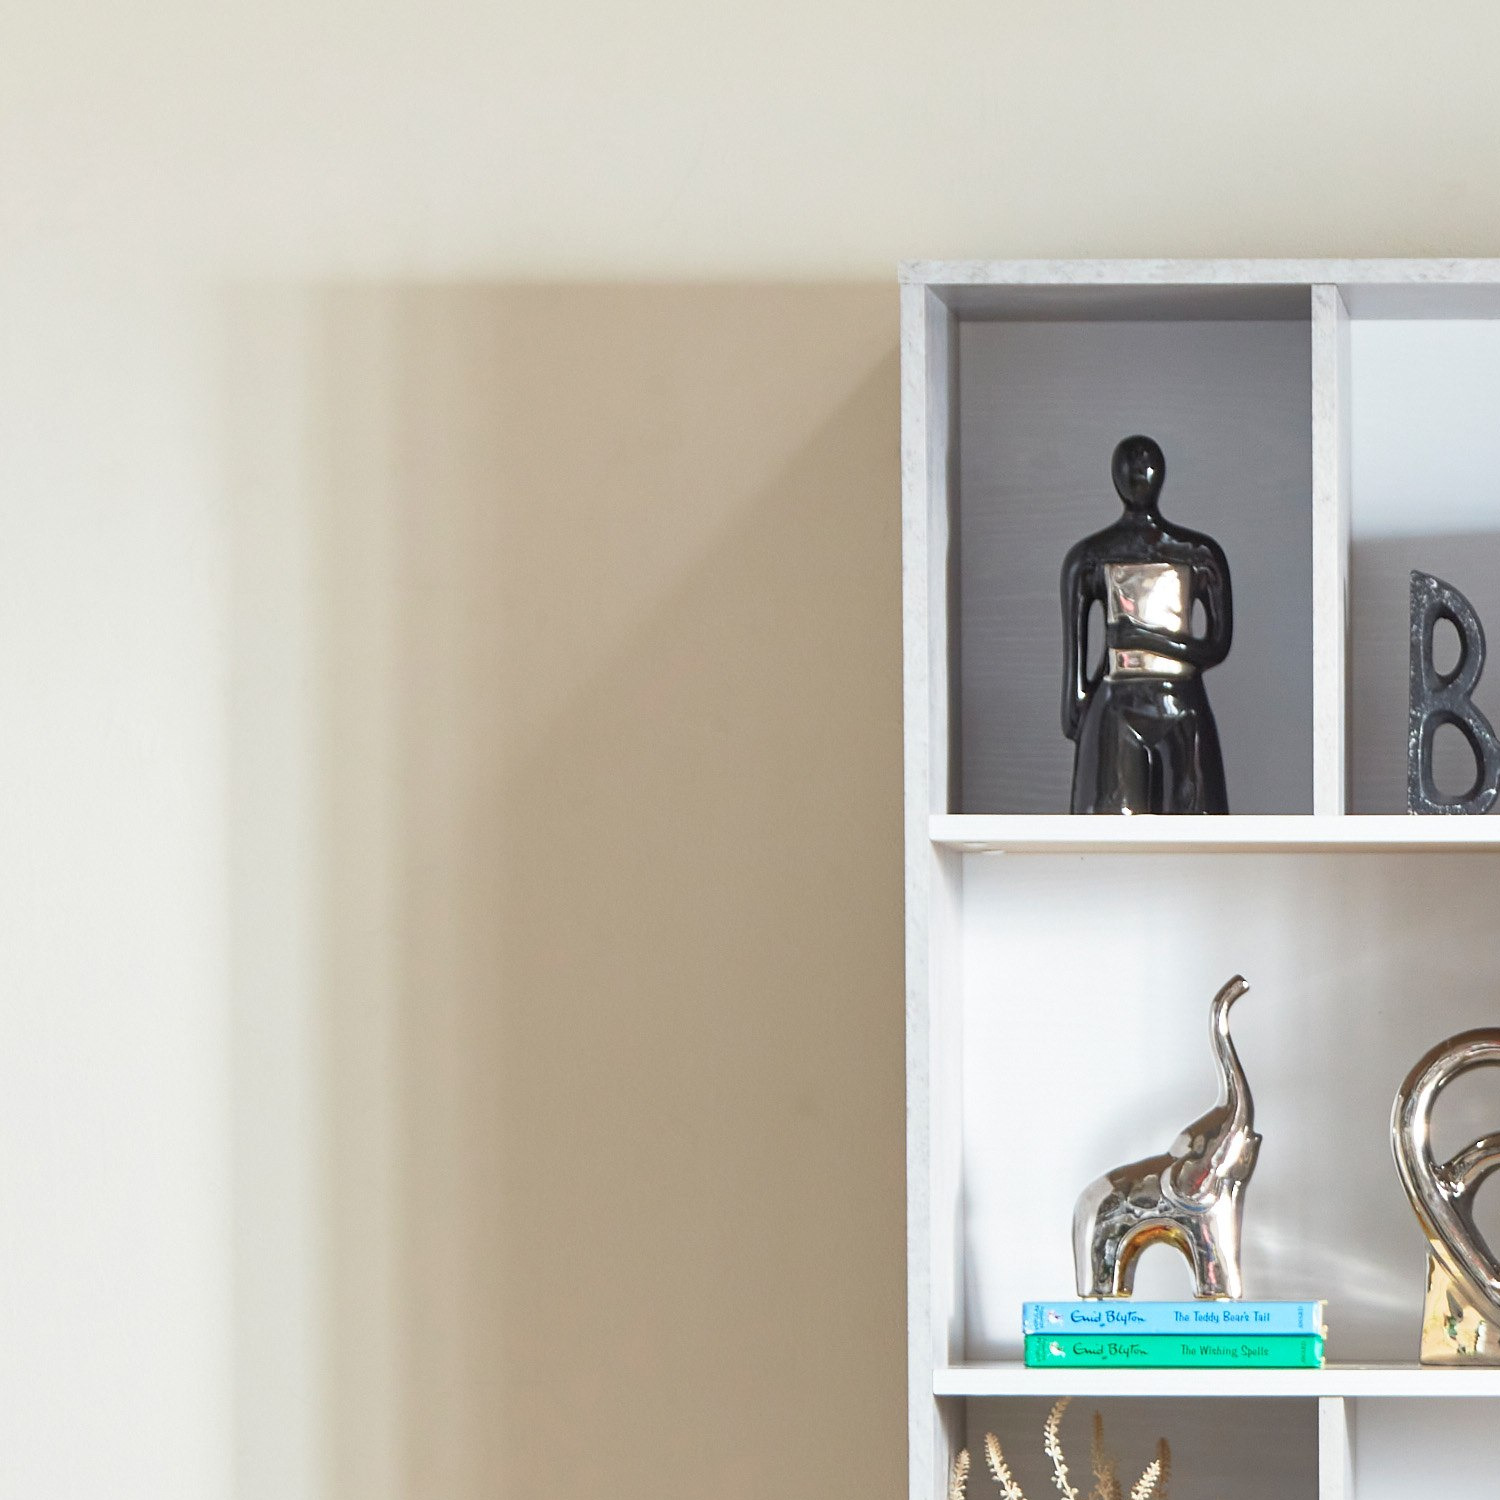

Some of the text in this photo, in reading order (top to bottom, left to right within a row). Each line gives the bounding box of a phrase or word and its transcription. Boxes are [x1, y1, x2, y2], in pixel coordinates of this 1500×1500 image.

[1070, 1309, 1147, 1325] Enid Blyton
[1173, 1310, 1270, 1324] The Teddy Bear's Tail
[1072, 1342, 1149, 1358] Enid Blyton
[1181, 1344, 1269, 1358] The Wishing Spells
